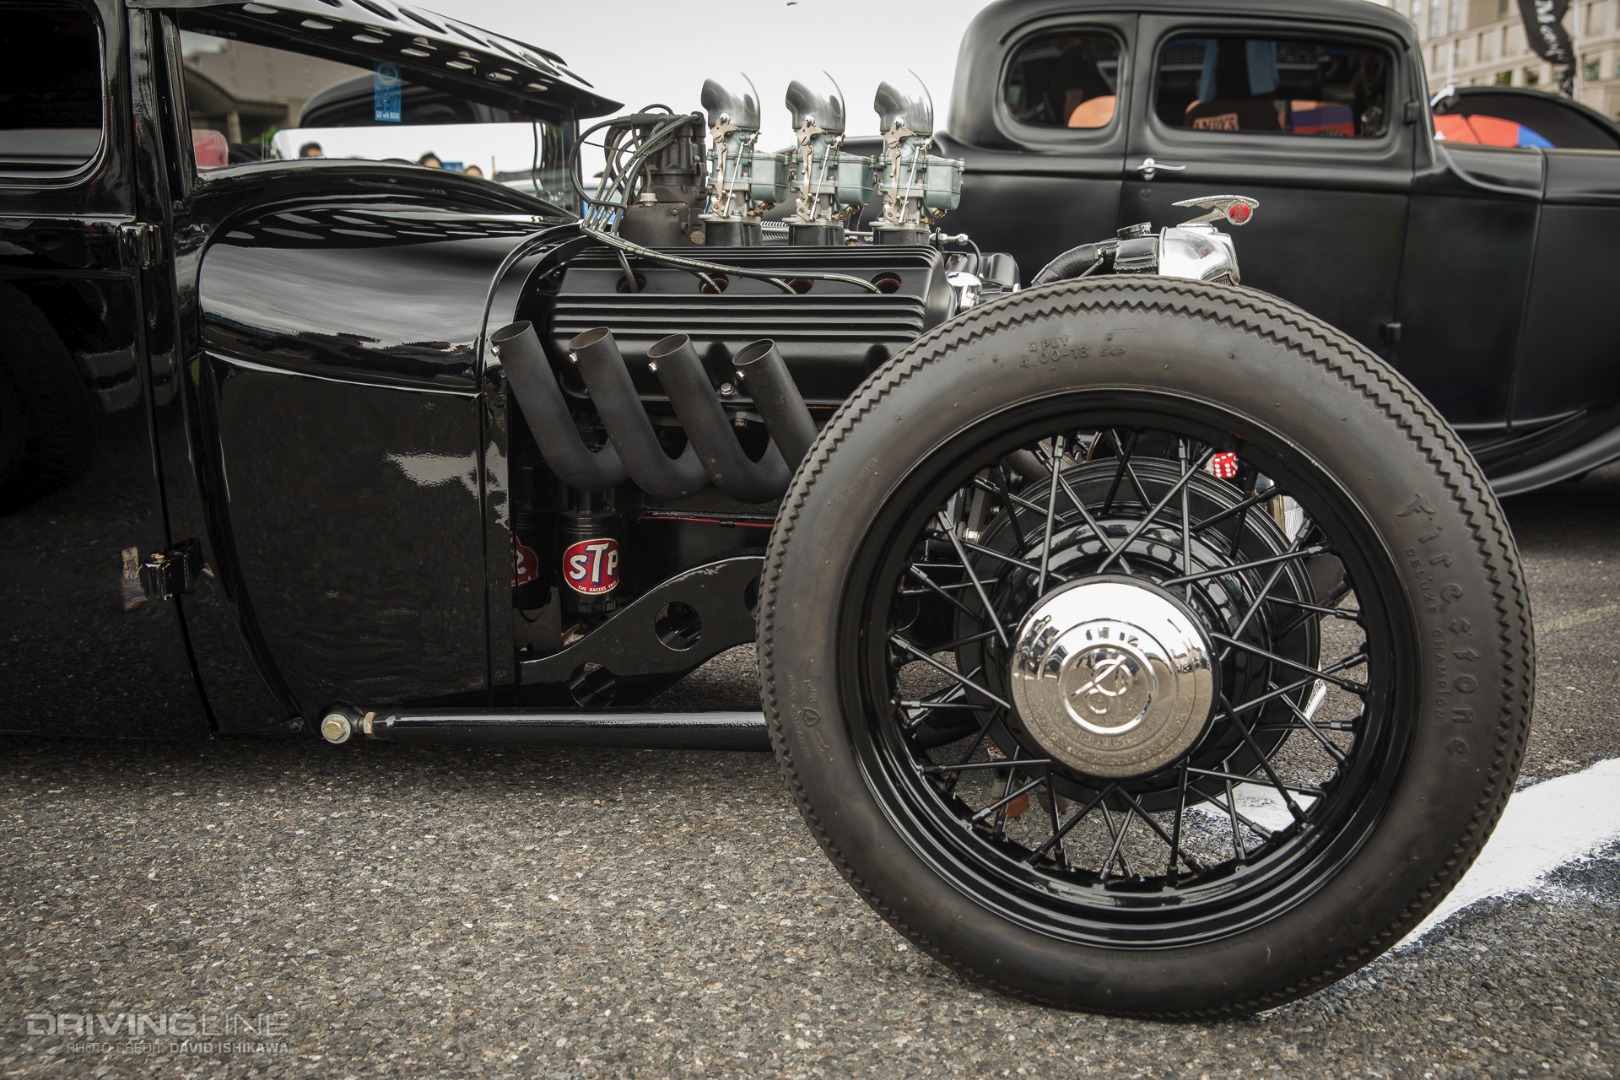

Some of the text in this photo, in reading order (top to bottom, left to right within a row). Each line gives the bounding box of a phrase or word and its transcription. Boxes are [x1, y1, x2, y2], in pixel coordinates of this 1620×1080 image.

[1041, 334, 1070, 349] PLY
[569, 542, 619, 582] STP
[1405, 546, 1439, 616] DELUXE
[1396, 492, 1480, 759] Firestone
[1432, 626, 1450, 720] CHAMPION
